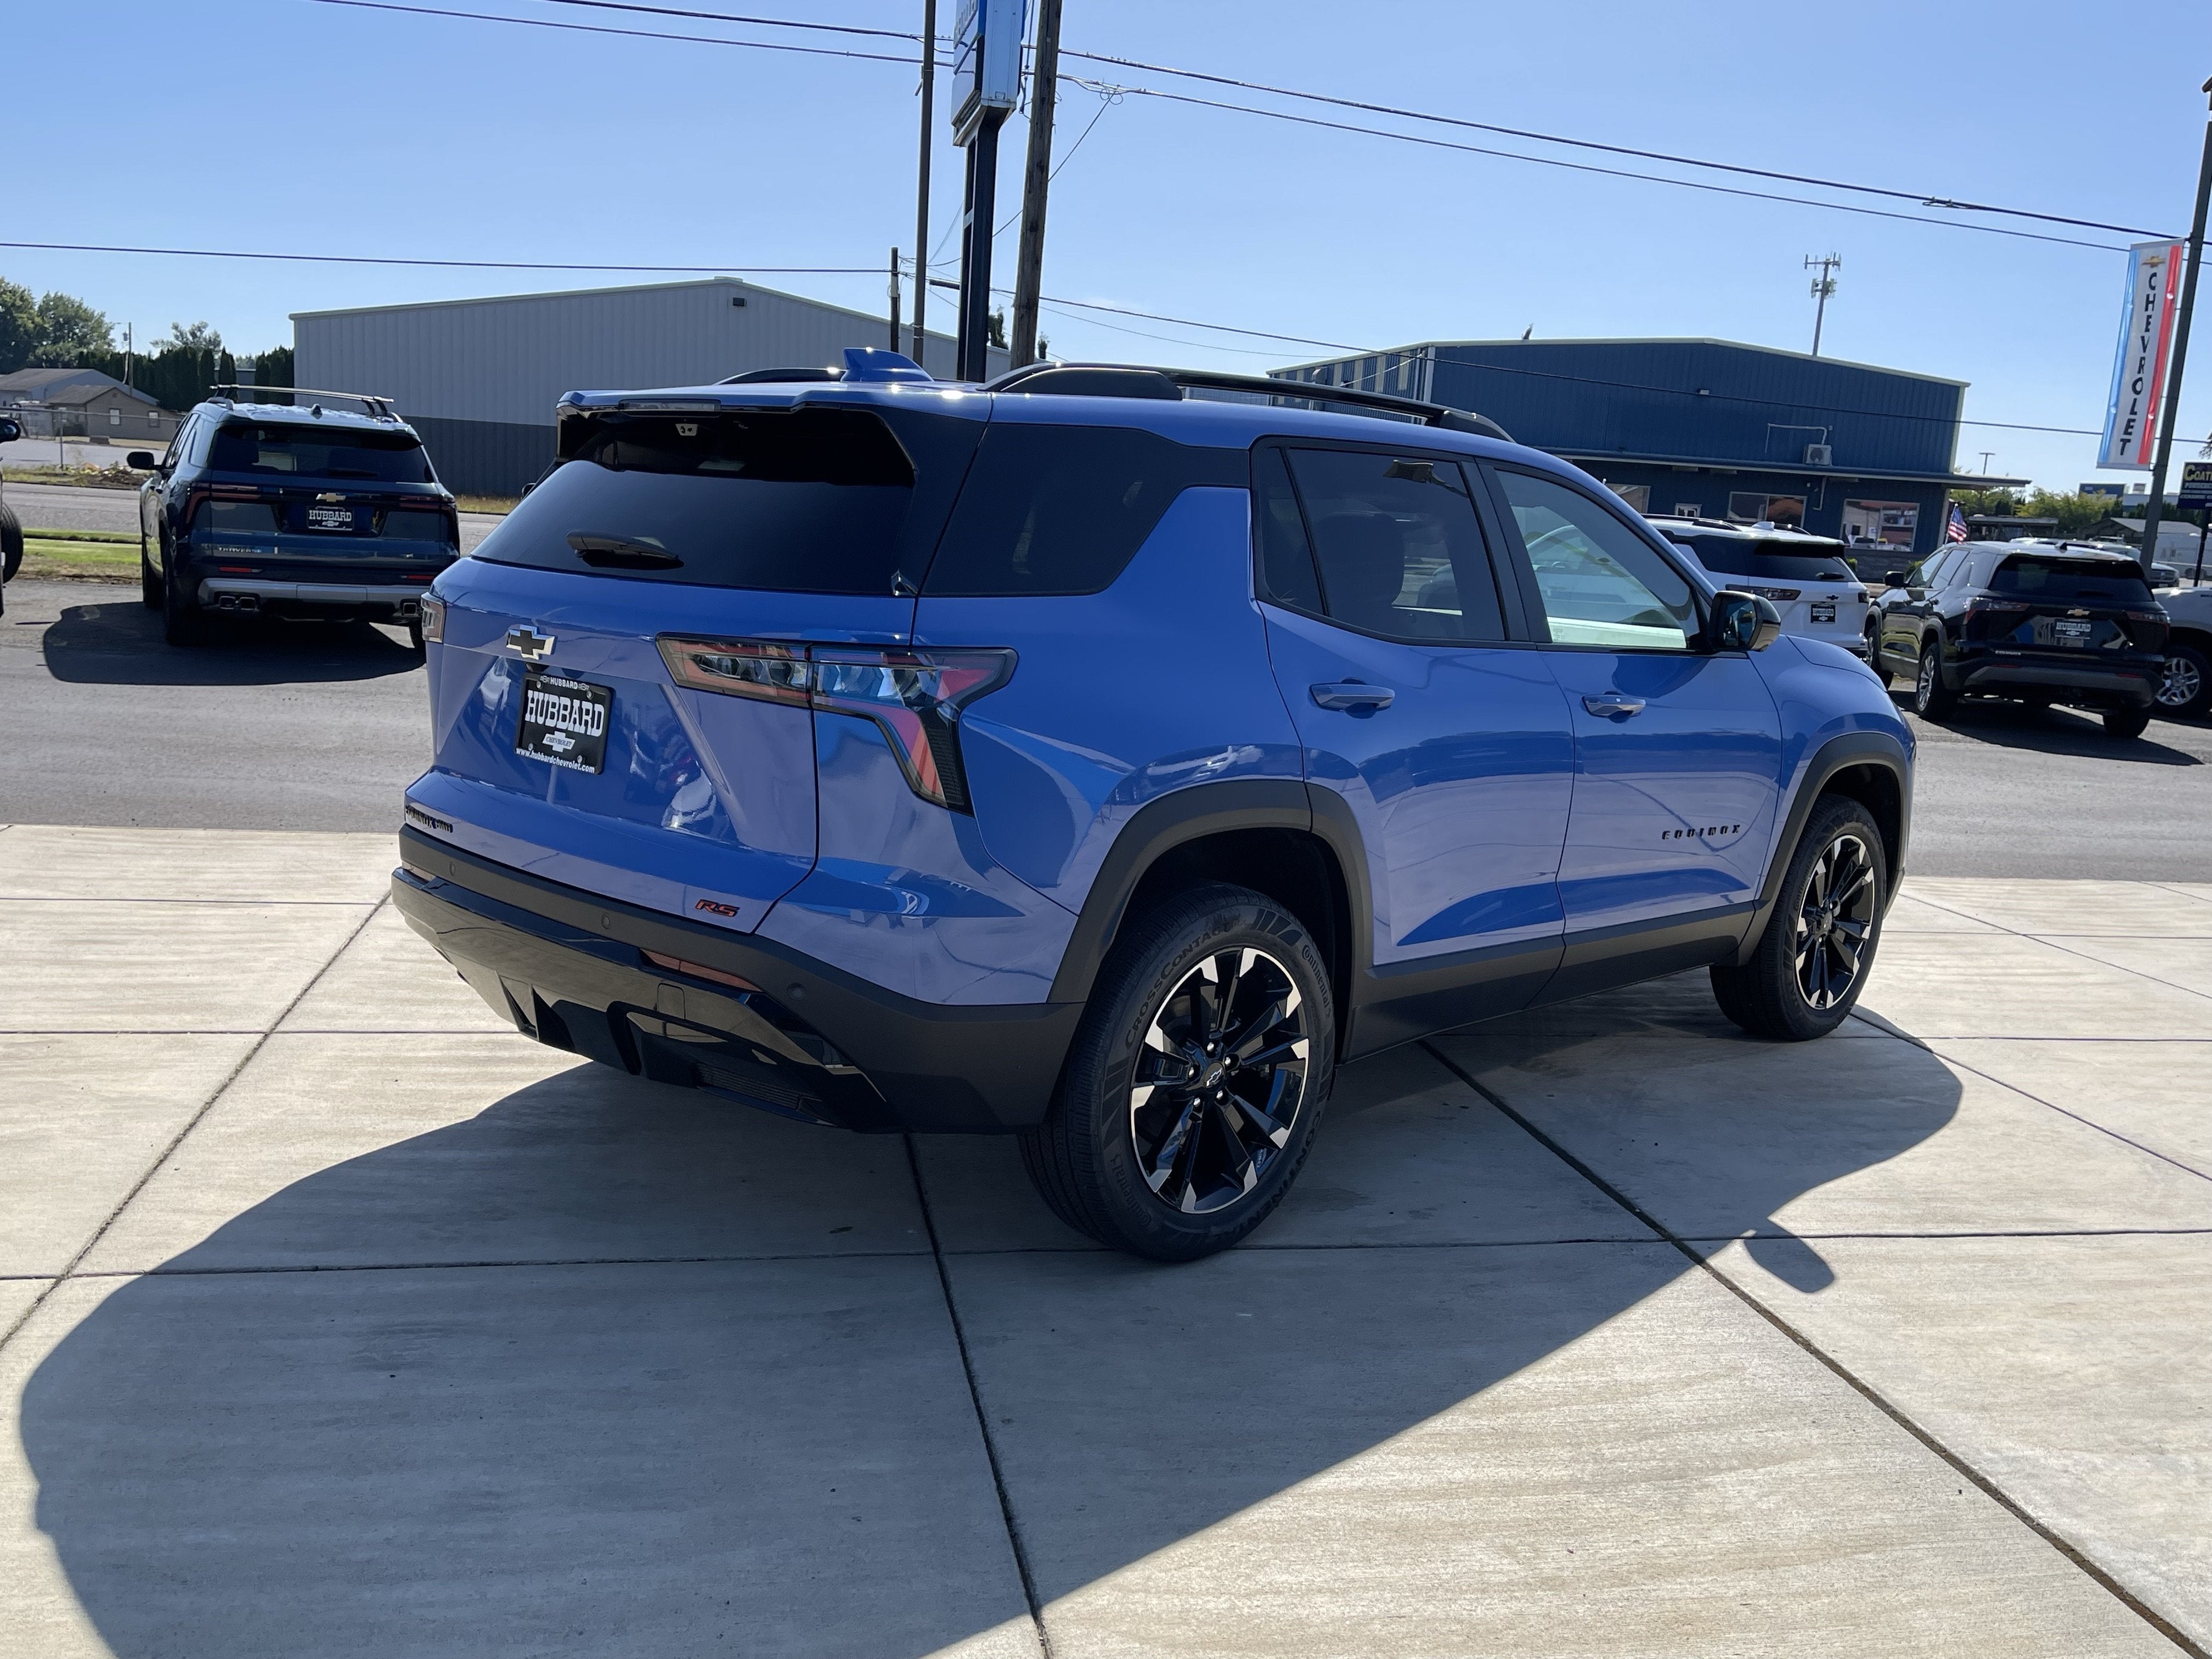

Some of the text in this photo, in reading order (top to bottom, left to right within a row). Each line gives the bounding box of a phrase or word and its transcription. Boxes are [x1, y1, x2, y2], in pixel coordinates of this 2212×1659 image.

[2119, 272, 2158, 456] CHEVROLET
[309, 510, 352, 522] HUBBARD
[550, 676, 578, 690] HUBBARD
[525, 690, 605, 737] HUBBARD
[546, 736, 572, 747] CHEVROLET
[516, 747, 595, 774] www.hubbardchevrolet.com
[1661, 824, 1741, 840] EQUINOX
[695, 899, 741, 917] RS
[1301, 943, 1330, 1009] Continental
